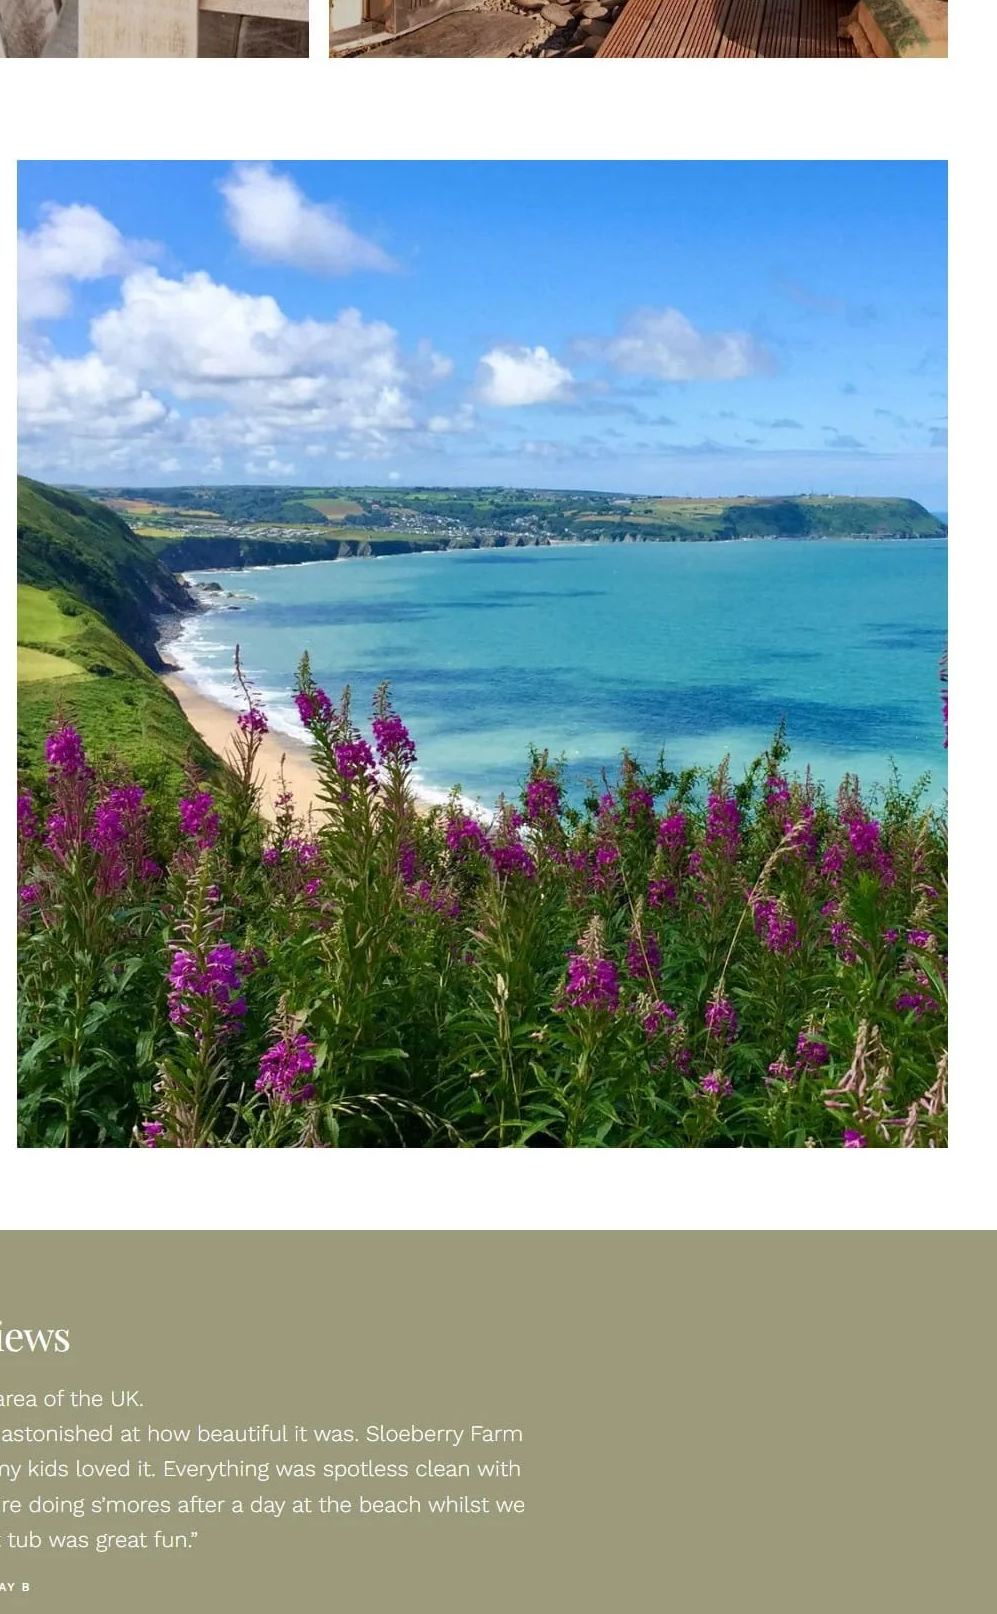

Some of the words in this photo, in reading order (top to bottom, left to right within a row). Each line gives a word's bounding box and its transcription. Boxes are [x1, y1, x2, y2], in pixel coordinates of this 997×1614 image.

[1, 1424, 113, 1443] astonished
[120, 1426, 141, 1443] at
[148, 1424, 191, 1443] how
[198, 1423, 289, 1443] beautiful
[294, 1425, 308, 1443] it
[313, 1428, 359, 1443] was.
[366, 1424, 465, 1447] Sloeberry
[471, 1425, 523, 1443] Farm
[21, 1582, 30, 1592] B
